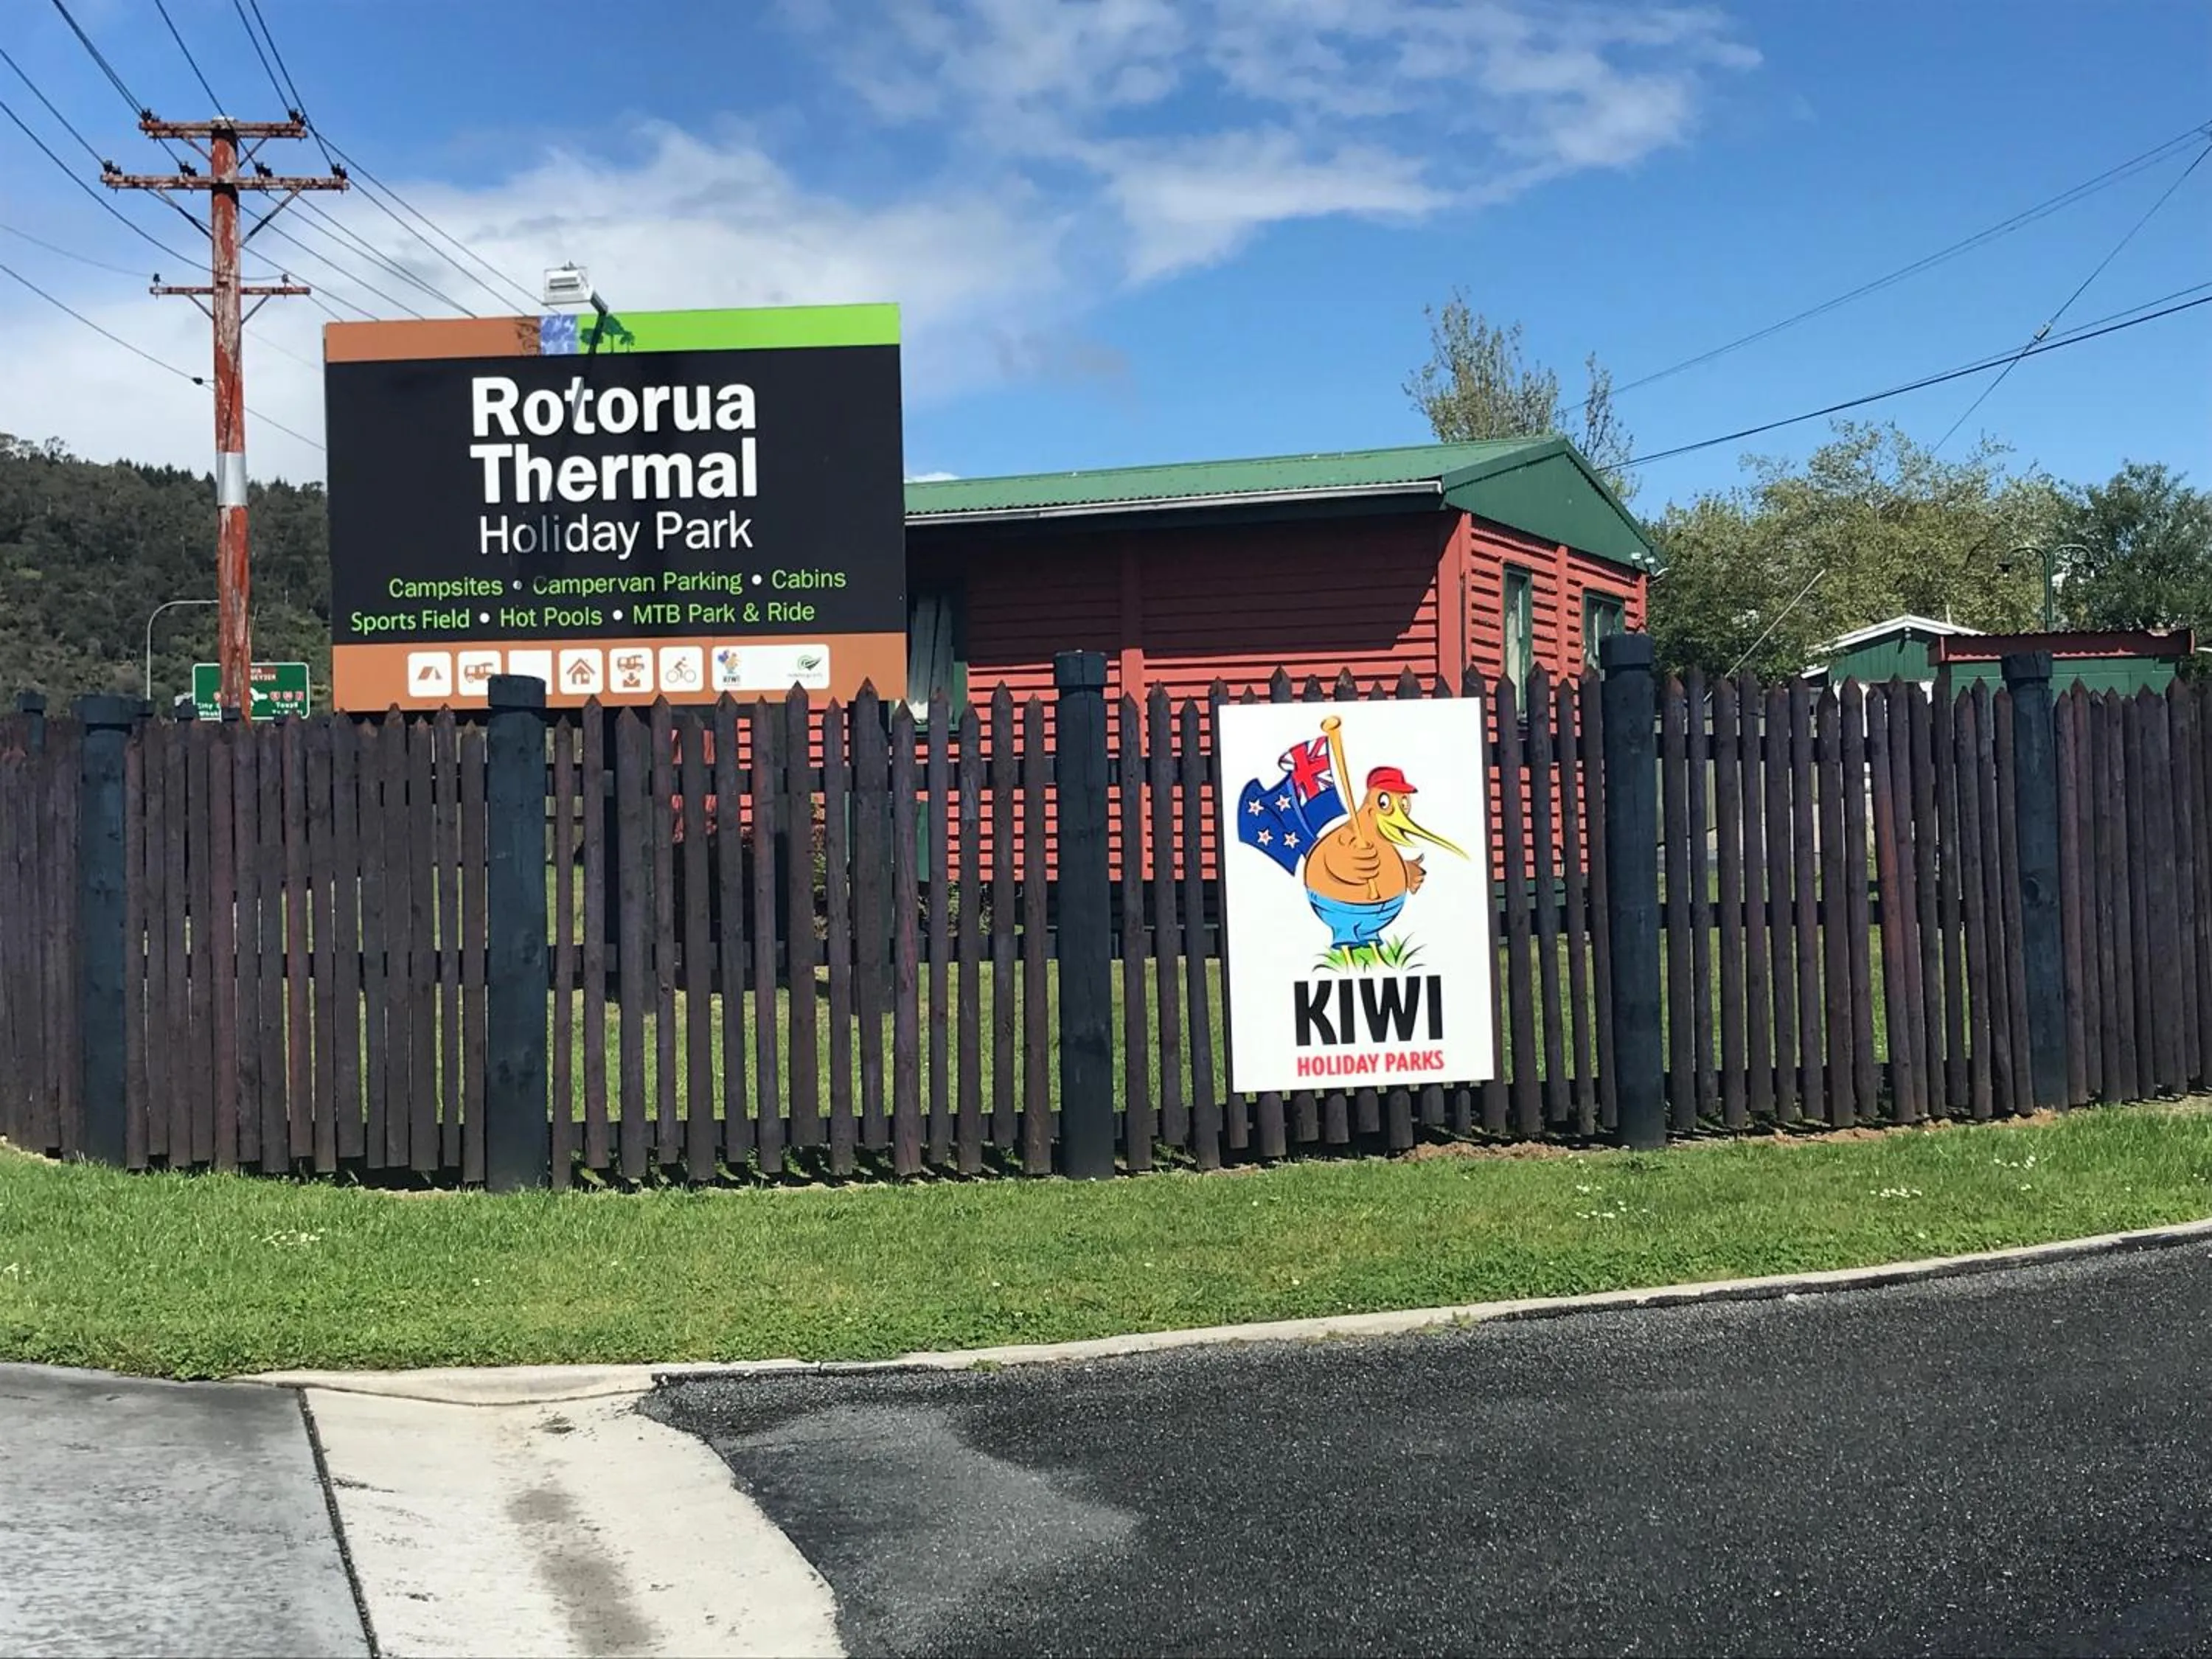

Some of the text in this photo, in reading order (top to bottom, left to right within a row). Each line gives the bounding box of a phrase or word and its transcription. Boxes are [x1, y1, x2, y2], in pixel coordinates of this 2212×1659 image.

[471, 376, 757, 437] Rotorua
[469, 437, 757, 504] Thermal
[480, 509, 754, 560] Holiday Park
[389, 568, 846, 601] Campsites Campervan Parking Cabins
[350, 601, 815, 636] Sports Field Hot Pools MTB Park & Ride
[1293, 975, 1444, 1046] KIWI
[1297, 1050, 1445, 1077] HOLIDAY PARKS
